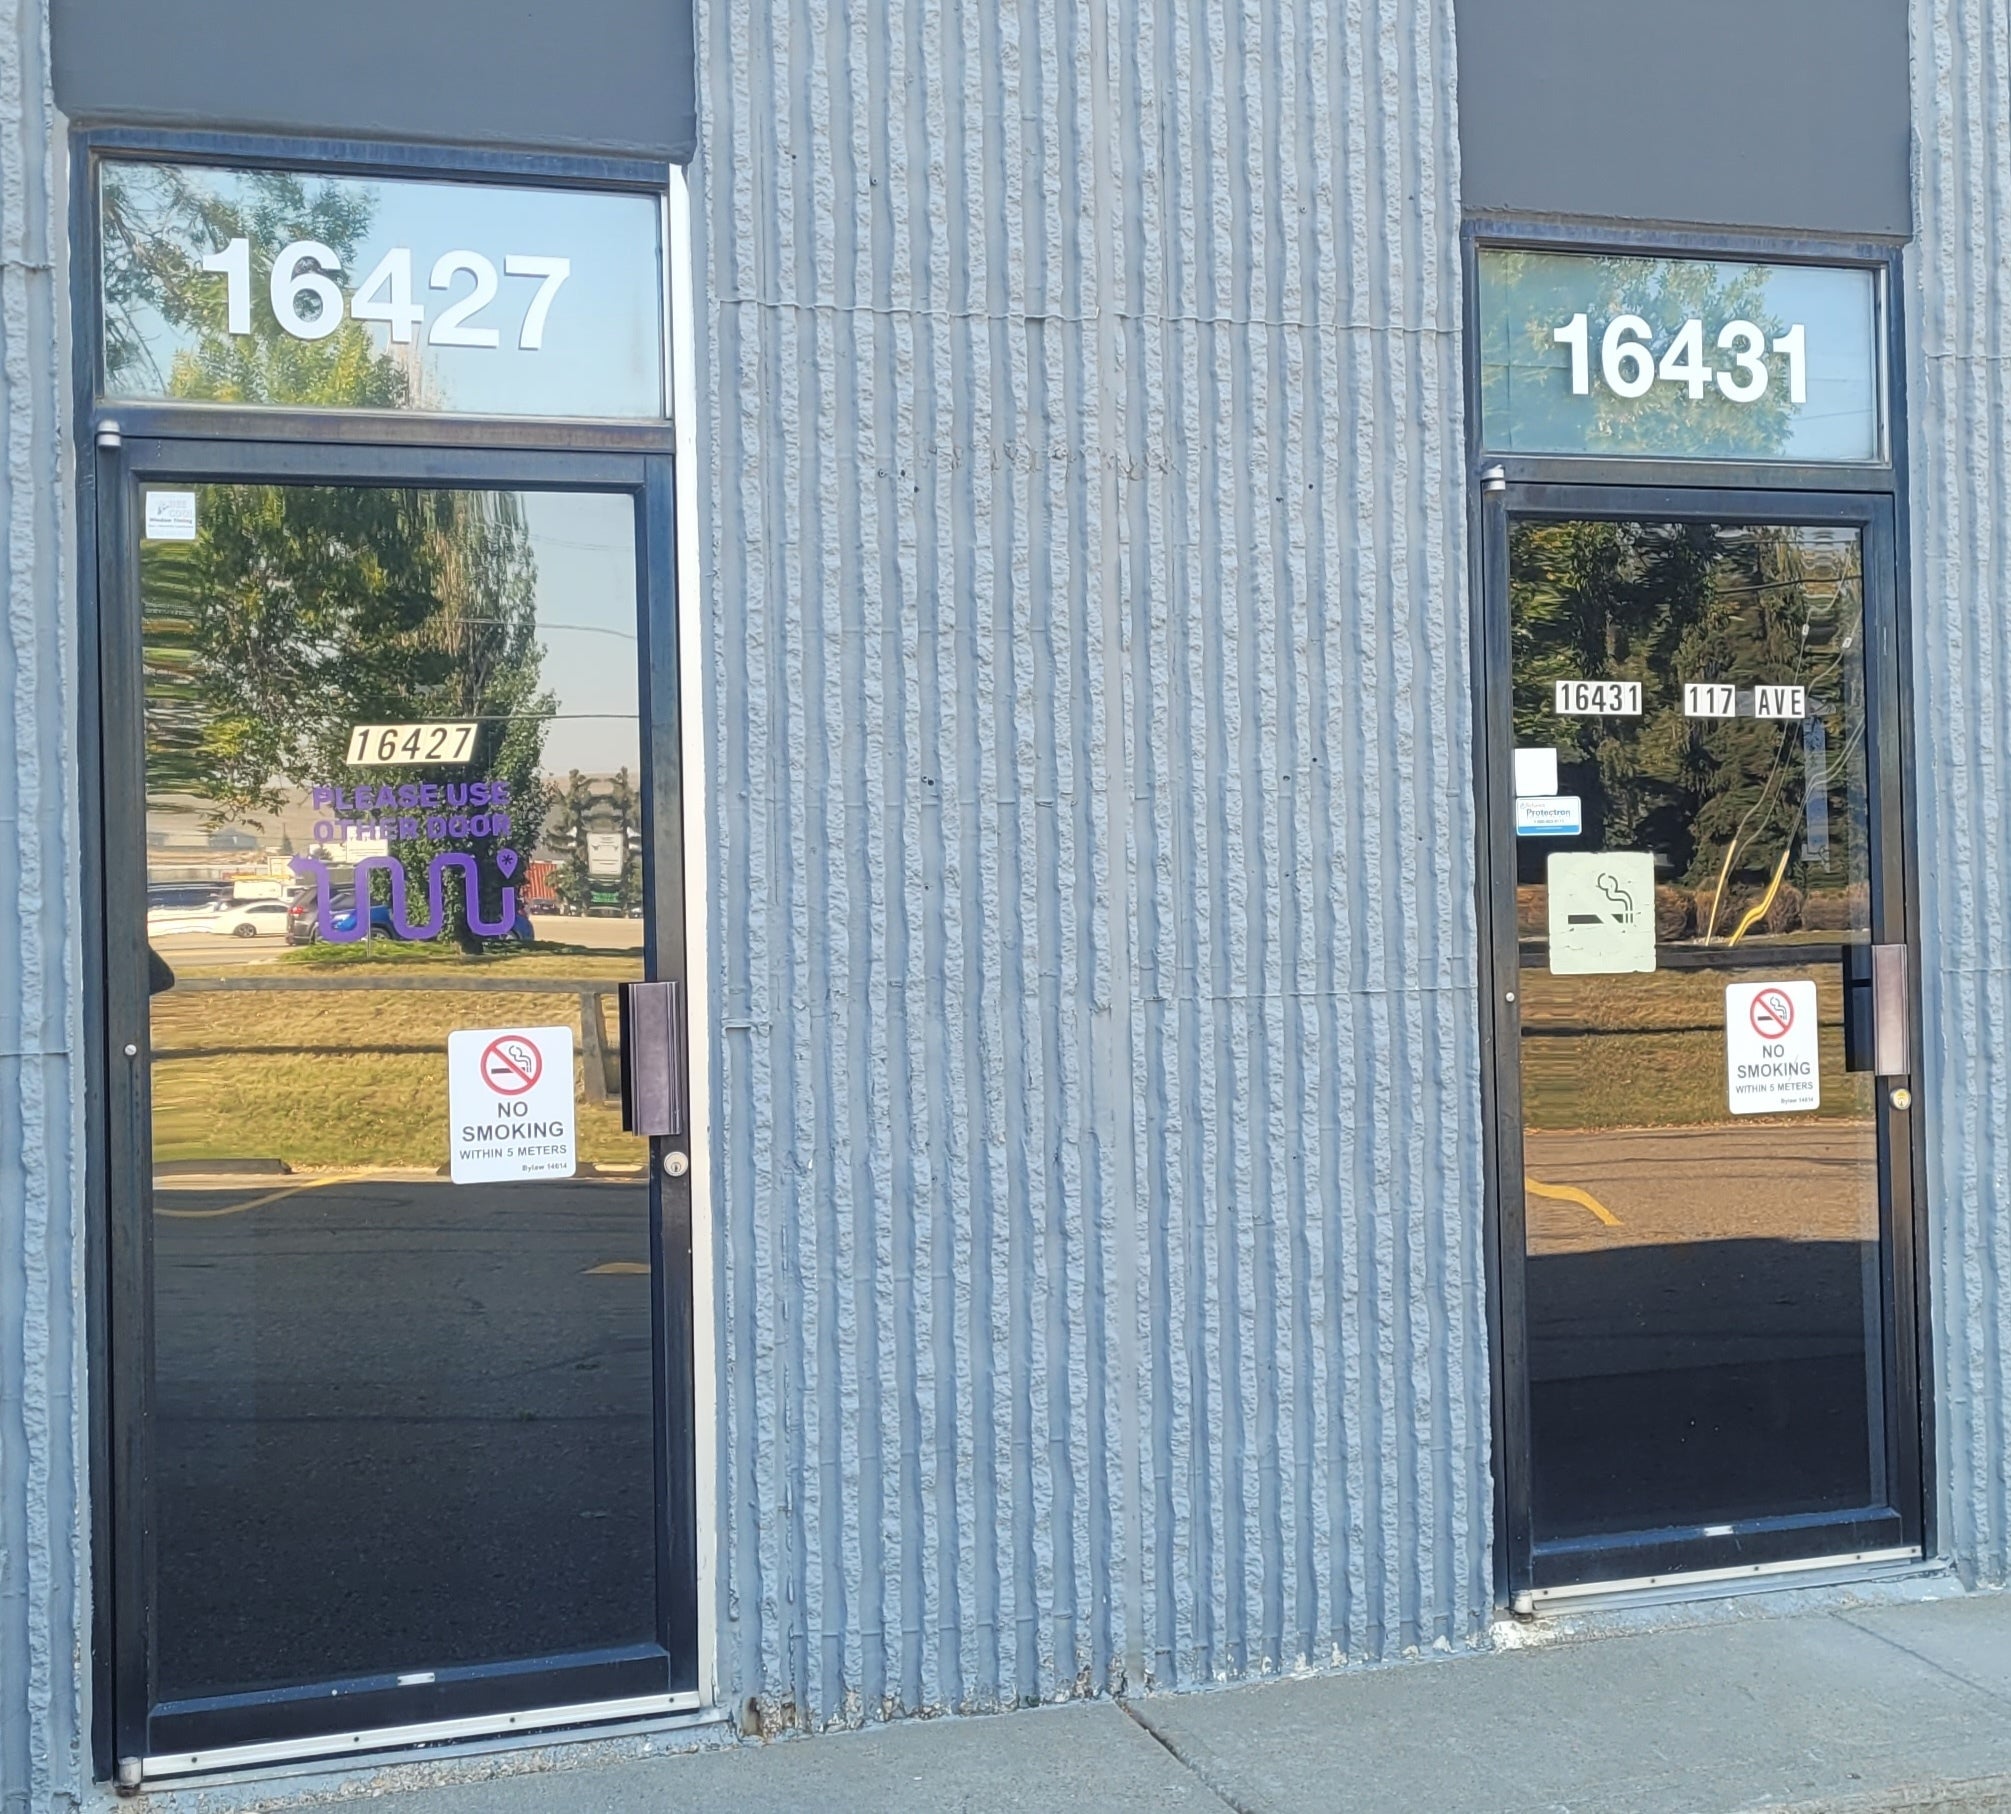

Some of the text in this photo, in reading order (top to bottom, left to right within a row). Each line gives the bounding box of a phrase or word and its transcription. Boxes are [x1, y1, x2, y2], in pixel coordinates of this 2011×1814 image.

[202, 237, 571, 351] 16427
[1553, 313, 1807, 404] 16431
[1560, 683, 1802, 716] 16431 117 AVE
[357, 727, 472, 761] 16427
[313, 781, 511, 811] PLEASE USE
[1526, 808, 1571, 817] Protectron
[313, 812, 512, 843] OTHER DOOR
[1762, 1044, 1785, 1058] NO
[1737, 1062, 1811, 1078] SMOKING
[1736, 1082, 1813, 1094] WITHIN 5 METERS
[498, 1101, 528, 1118] NO
[462, 1121, 564, 1142] SMOKING
[459, 1145, 567, 1160] WITHIN 5 METERS
[522, 1164, 545, 1172] Bylaw
